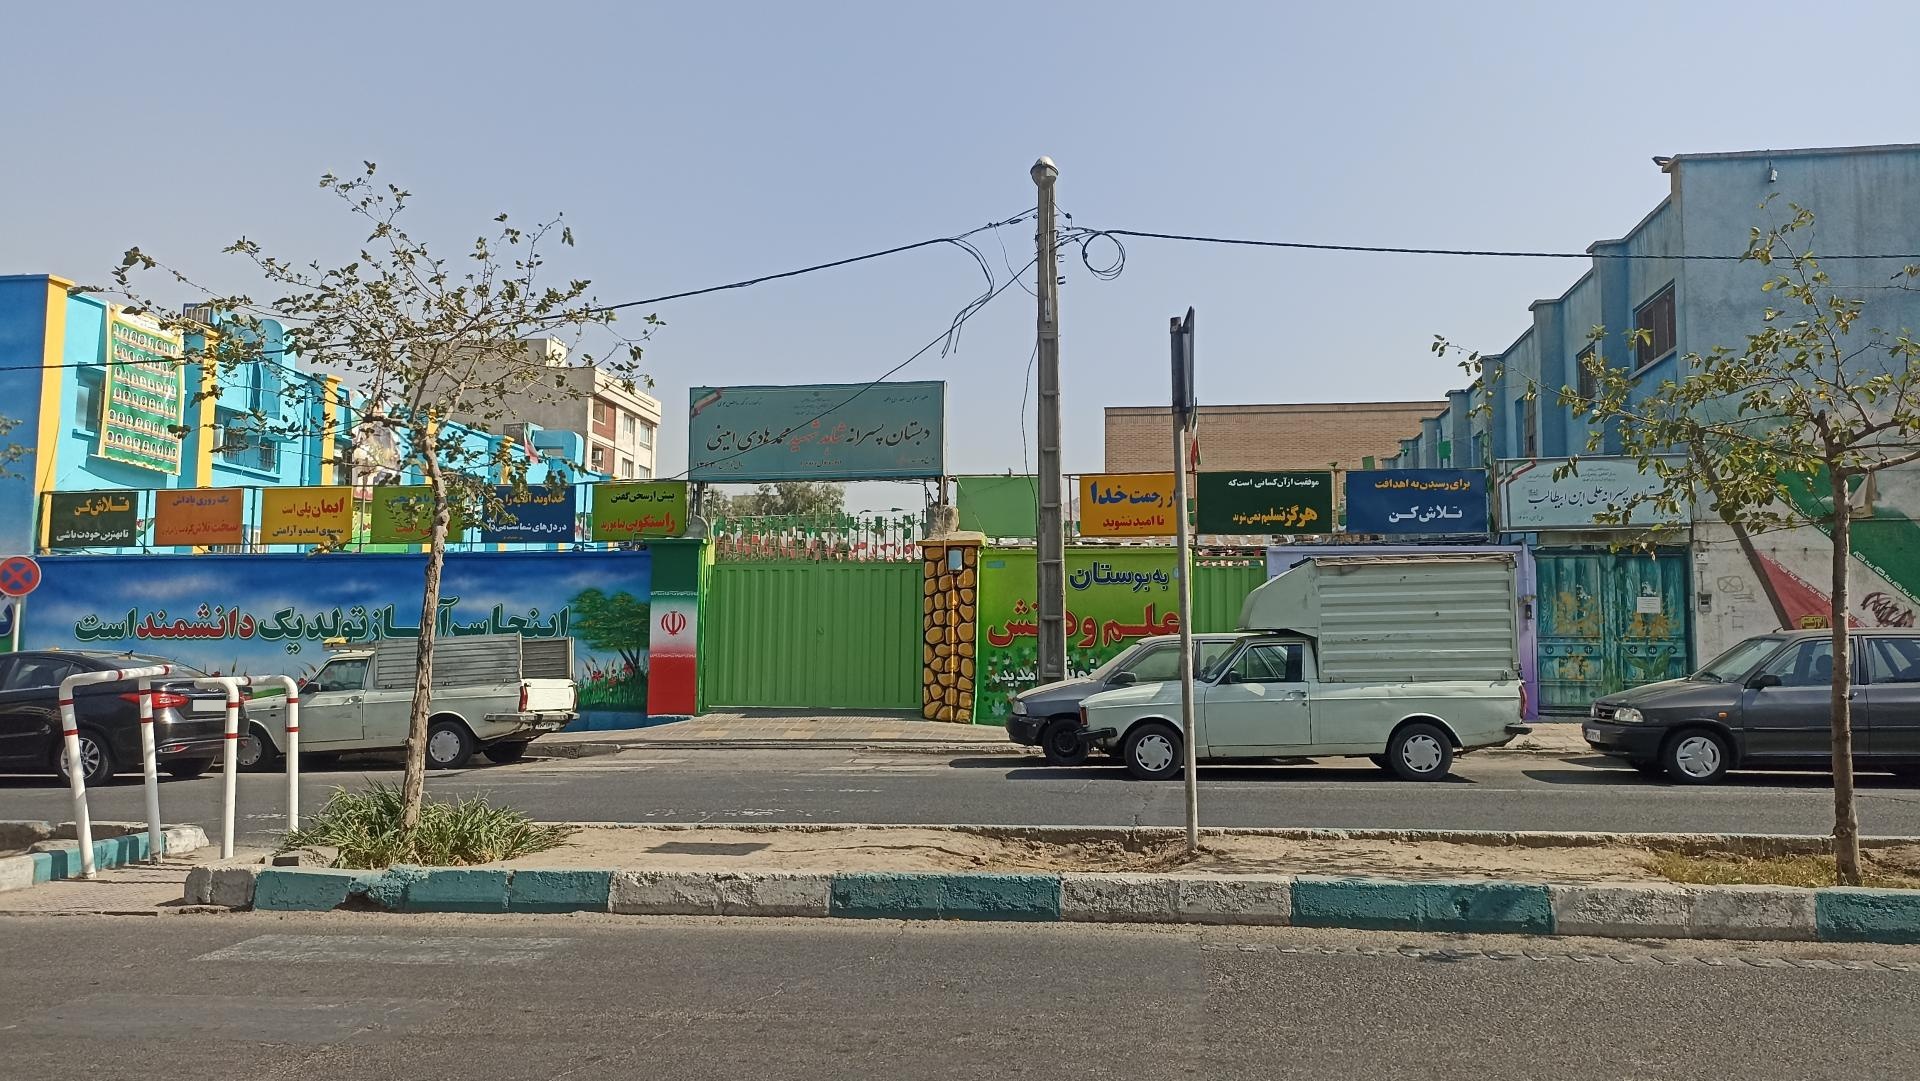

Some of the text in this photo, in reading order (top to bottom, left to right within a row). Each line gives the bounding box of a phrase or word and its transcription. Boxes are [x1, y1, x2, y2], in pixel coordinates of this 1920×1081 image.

[706, 424, 736, 451] امینی
[737, 427, 770, 451] هادی
[846, 424, 884, 446] پسرانه
[886, 420, 930, 446] دبستان
[1228, 478, 1238, 487] که
[1236, 478, 1252, 487] است
[1254, 478, 1278, 488] کسانی
[1294, 476, 1319, 488] موفقیت
[1375, 478, 1471, 491] برای رسیدن به اهدافت
[505, 494, 513, 506] را
[534, 493, 565, 506] خداوند
[610, 491, 630, 503] گفتن
[629, 491, 649, 503] سخن
[1090, 481, 1128, 504] خدا
[1130, 490, 1163, 508] رحمت
[1528, 490, 1567, 509] ابیطالب
[1568, 491, 1585, 507] ابن
[1587, 486, 1603, 504] علی
[1602, 486, 1629, 504] پسرانه
[74, 496, 130, 516] تلاش کن
[282, 496, 345, 519] ایمان پلی است
[1388, 505, 1463, 523] تلاش کن
[1102, 515, 1132, 531] نشوید
[1262, 507, 1286, 526] تسلیم
[1284, 504, 1318, 527] هرگز
[56, 529, 129, 542] تا بهترین خودت باشی
[272, 525, 297, 537] آرامش
[303, 526, 319, 536] امید
[319, 528, 337, 537] سوی
[558, 523, 567, 532] در
[1069, 561, 1169, 592] به بوستان
[74, 607, 137, 641] است
[135, 603, 256, 640] دانشمند
[257, 606, 304, 654] یک
[305, 606, 368, 641] تولد
[1102, 601, 1181, 647] علم
[1077, 616, 1098, 648] و
